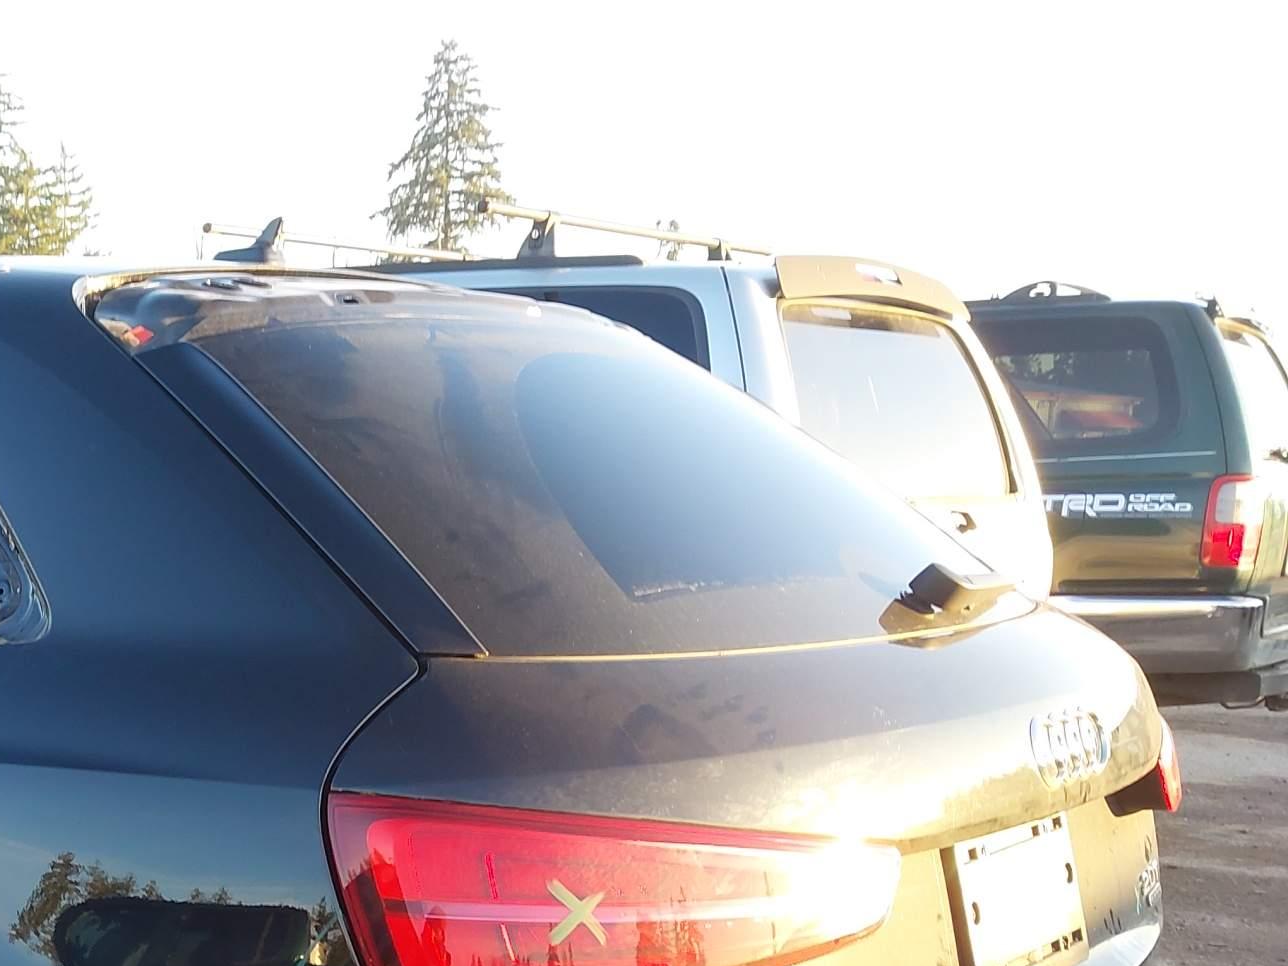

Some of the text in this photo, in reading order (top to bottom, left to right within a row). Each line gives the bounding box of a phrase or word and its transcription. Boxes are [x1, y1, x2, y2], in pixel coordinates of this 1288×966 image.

[1043, 493, 1176, 517] TRD OFF
[1127, 502, 1193, 512] ROAD
